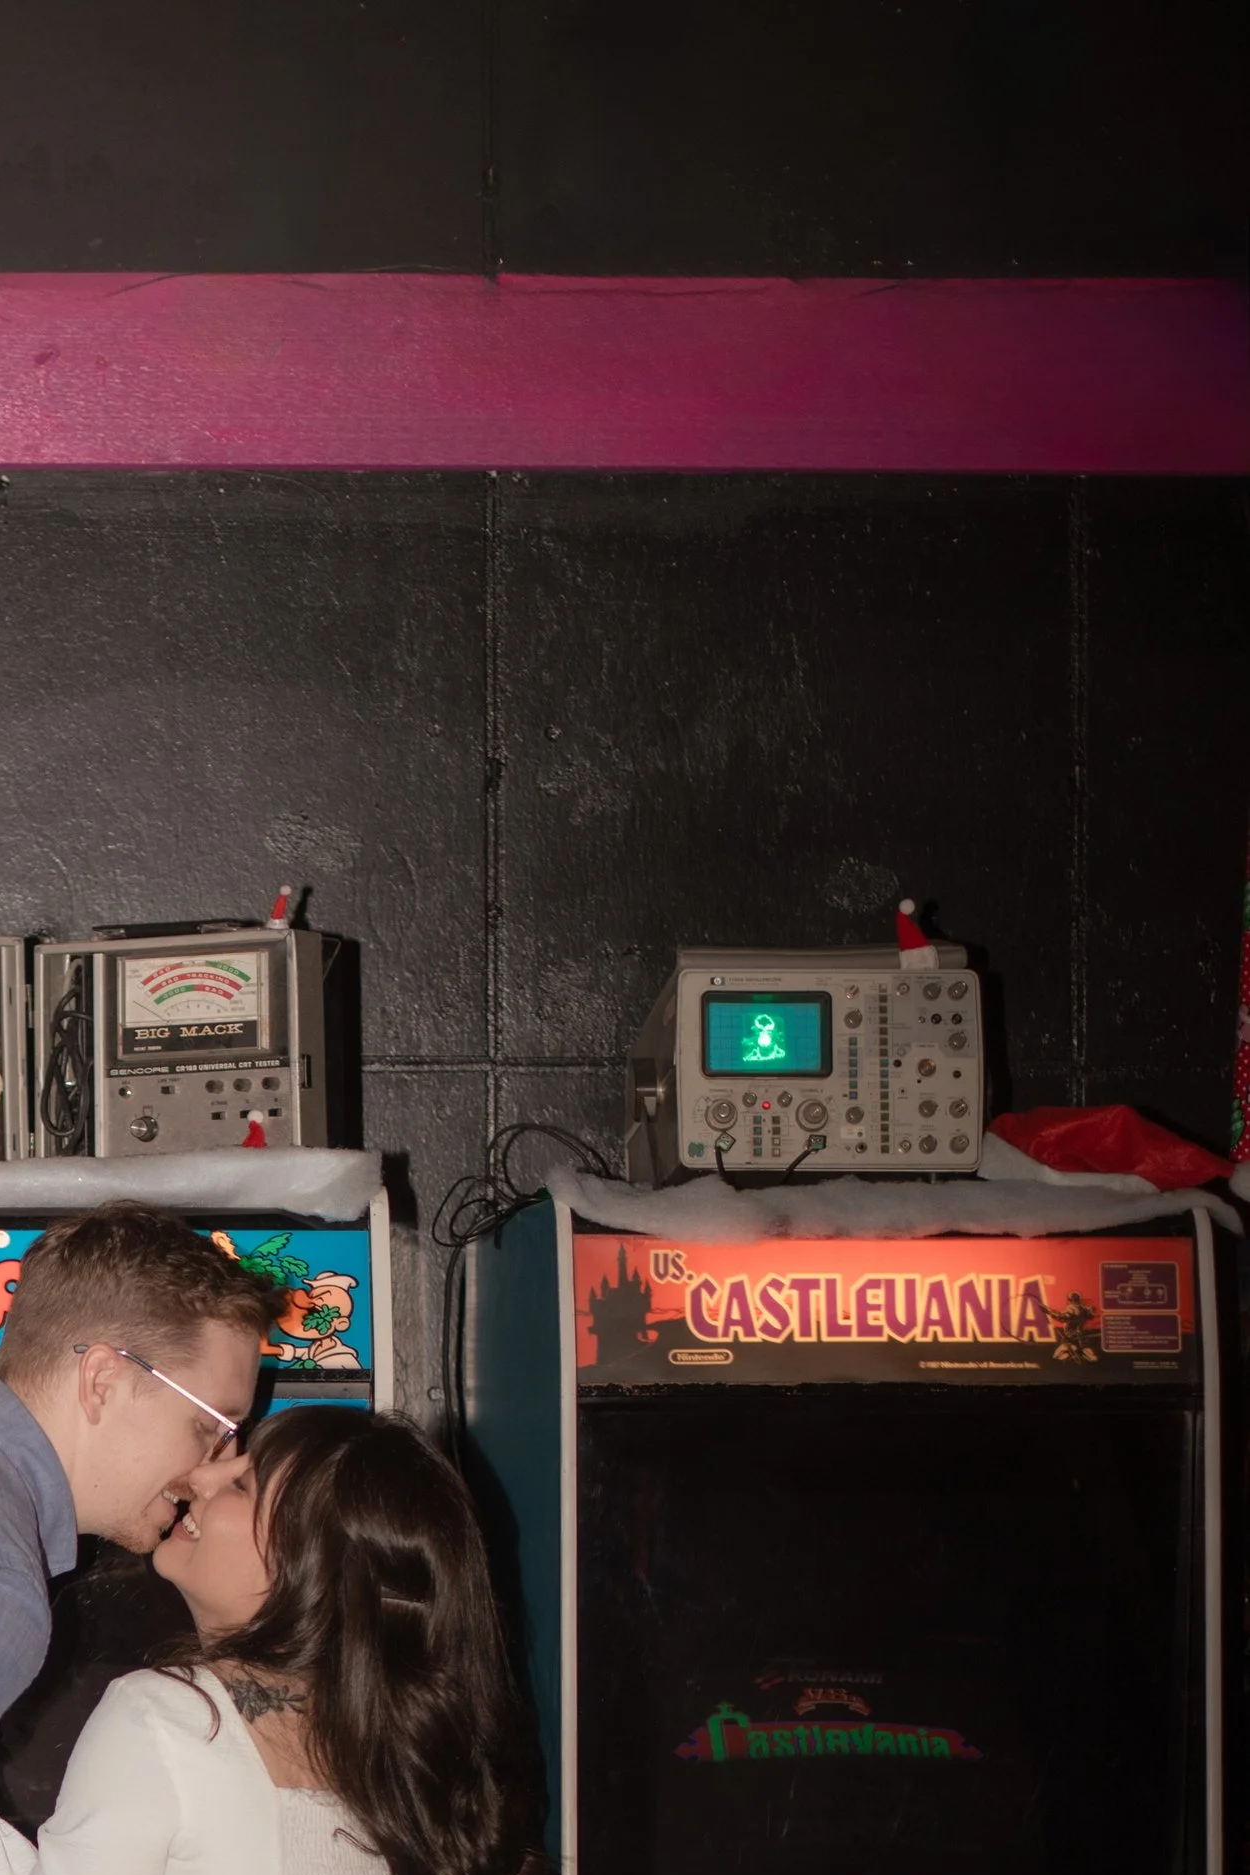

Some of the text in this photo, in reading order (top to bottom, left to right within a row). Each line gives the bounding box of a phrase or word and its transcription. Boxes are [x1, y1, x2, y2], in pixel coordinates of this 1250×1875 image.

[134, 1023, 244, 1040] BIG MACK
[110, 1066, 170, 1076] SENCORE
[199, 1062, 236, 1070] UNIVERSAL
[685, 1272, 1055, 1343] CASTLEVANIA
[676, 1352, 726, 1362] Nintendo
